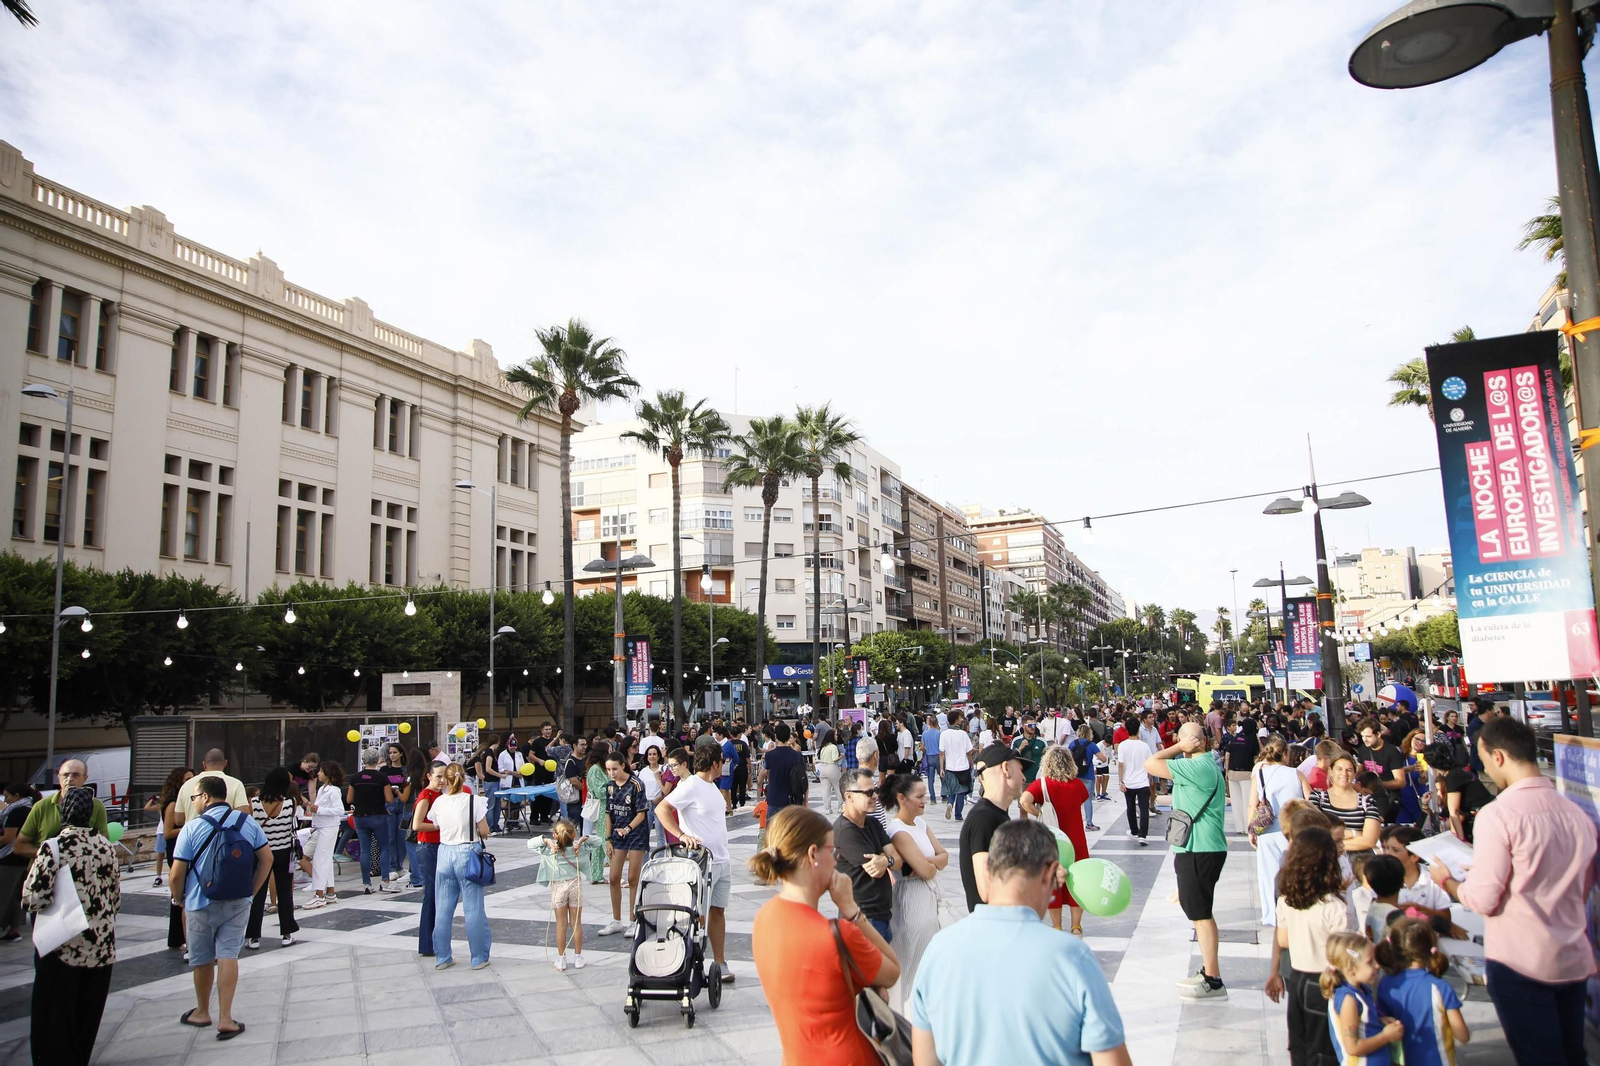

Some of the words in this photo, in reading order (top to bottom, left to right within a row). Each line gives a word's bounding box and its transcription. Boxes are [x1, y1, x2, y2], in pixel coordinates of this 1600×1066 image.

[1488, 375, 1511, 419] L@S
[1545, 376, 1556, 397] PARA
[1548, 396, 1560, 426] CIENCIA
[1442, 420, 1475, 428] UNIVERSIDAD
[1493, 423, 1516, 451] DE
[1553, 426, 1564, 451] HACEN
[1515, 371, 1560, 553] INVESTIGADOR@S
[1469, 446, 1497, 520] NOCHE
[1499, 456, 1531, 555] EUROPEA
[1480, 528, 1502, 558] LA
[1468, 574, 1483, 584] La
[1484, 569, 1536, 582] CIENCIA
[1537, 567, 1552, 578] de
[1470, 587, 1483, 597] tu
[1484, 578, 1571, 595] UNIVERSIDAD
[1471, 598, 1485, 608] en
[1486, 597, 1497, 606] la
[1498, 593, 1541, 605] CALLE
[1483, 623, 1509, 631] ruleta
[1511, 621, 1521, 630] de
[1523, 620, 1532, 628] la
[1571, 621, 1591, 636] 63
[1471, 635, 1506, 643] diabetes
